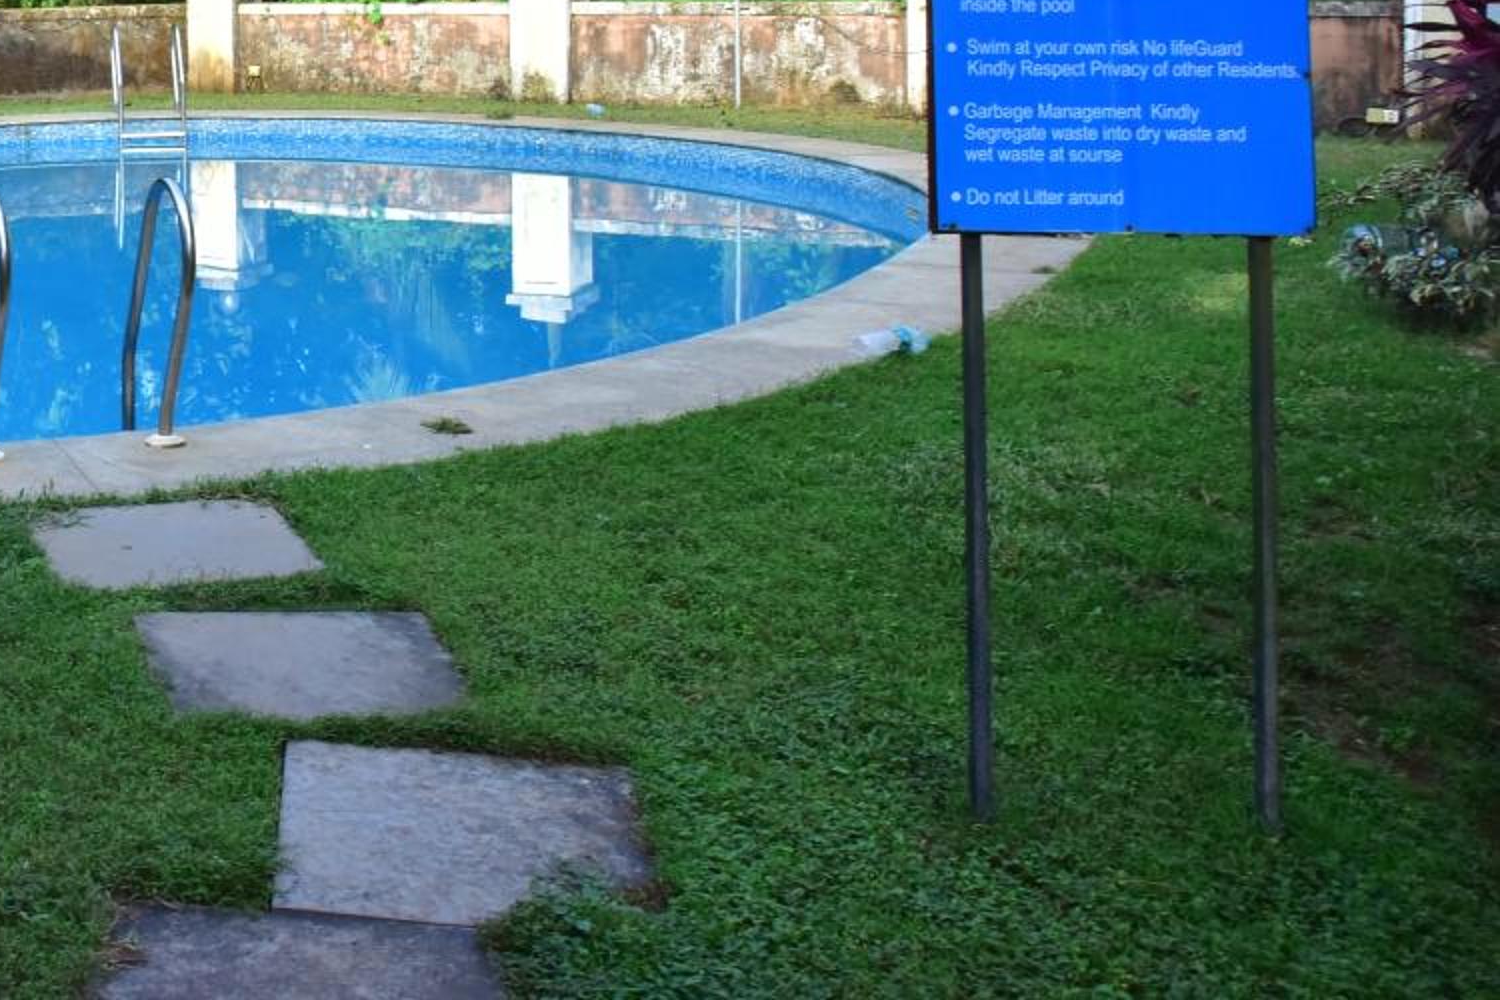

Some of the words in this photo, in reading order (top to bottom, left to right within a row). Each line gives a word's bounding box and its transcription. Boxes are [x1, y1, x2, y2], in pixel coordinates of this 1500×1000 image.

[966, 39, 1010, 55] Swim
[1015, 40, 1031, 55] at
[1034, 43, 1068, 60] your
[1074, 43, 1106, 56] own
[1111, 39, 1138, 56] risk
[1143, 40, 1166, 56] No
[967, 59, 1016, 80] Kindly
[1020, 60, 1086, 80] Respect
[1091, 61, 1147, 81] Privacy
[1152, 61, 1169, 77] of
[1173, 61, 1213, 78] other
[964, 102, 1033, 123] Garbage
[1037, 103, 1141, 123] Management
[1151, 104, 1200, 124] Kindly
[964, 124, 1046, 144] Segregate
[1051, 125, 1097, 141] waste
[1103, 125, 1132, 141] into
[1136, 125, 1161, 145] dry
[1166, 126, 1211, 142] waste
[1216, 126, 1247, 142] and
[964, 147, 994, 162] wet
[998, 147, 1044, 162] waste
[1049, 147, 1065, 163] at
[966, 188, 990, 205] Do
[994, 189, 1020, 205] not
[1024, 189, 1064, 205] Litter
[1068, 189, 1124, 206] around
